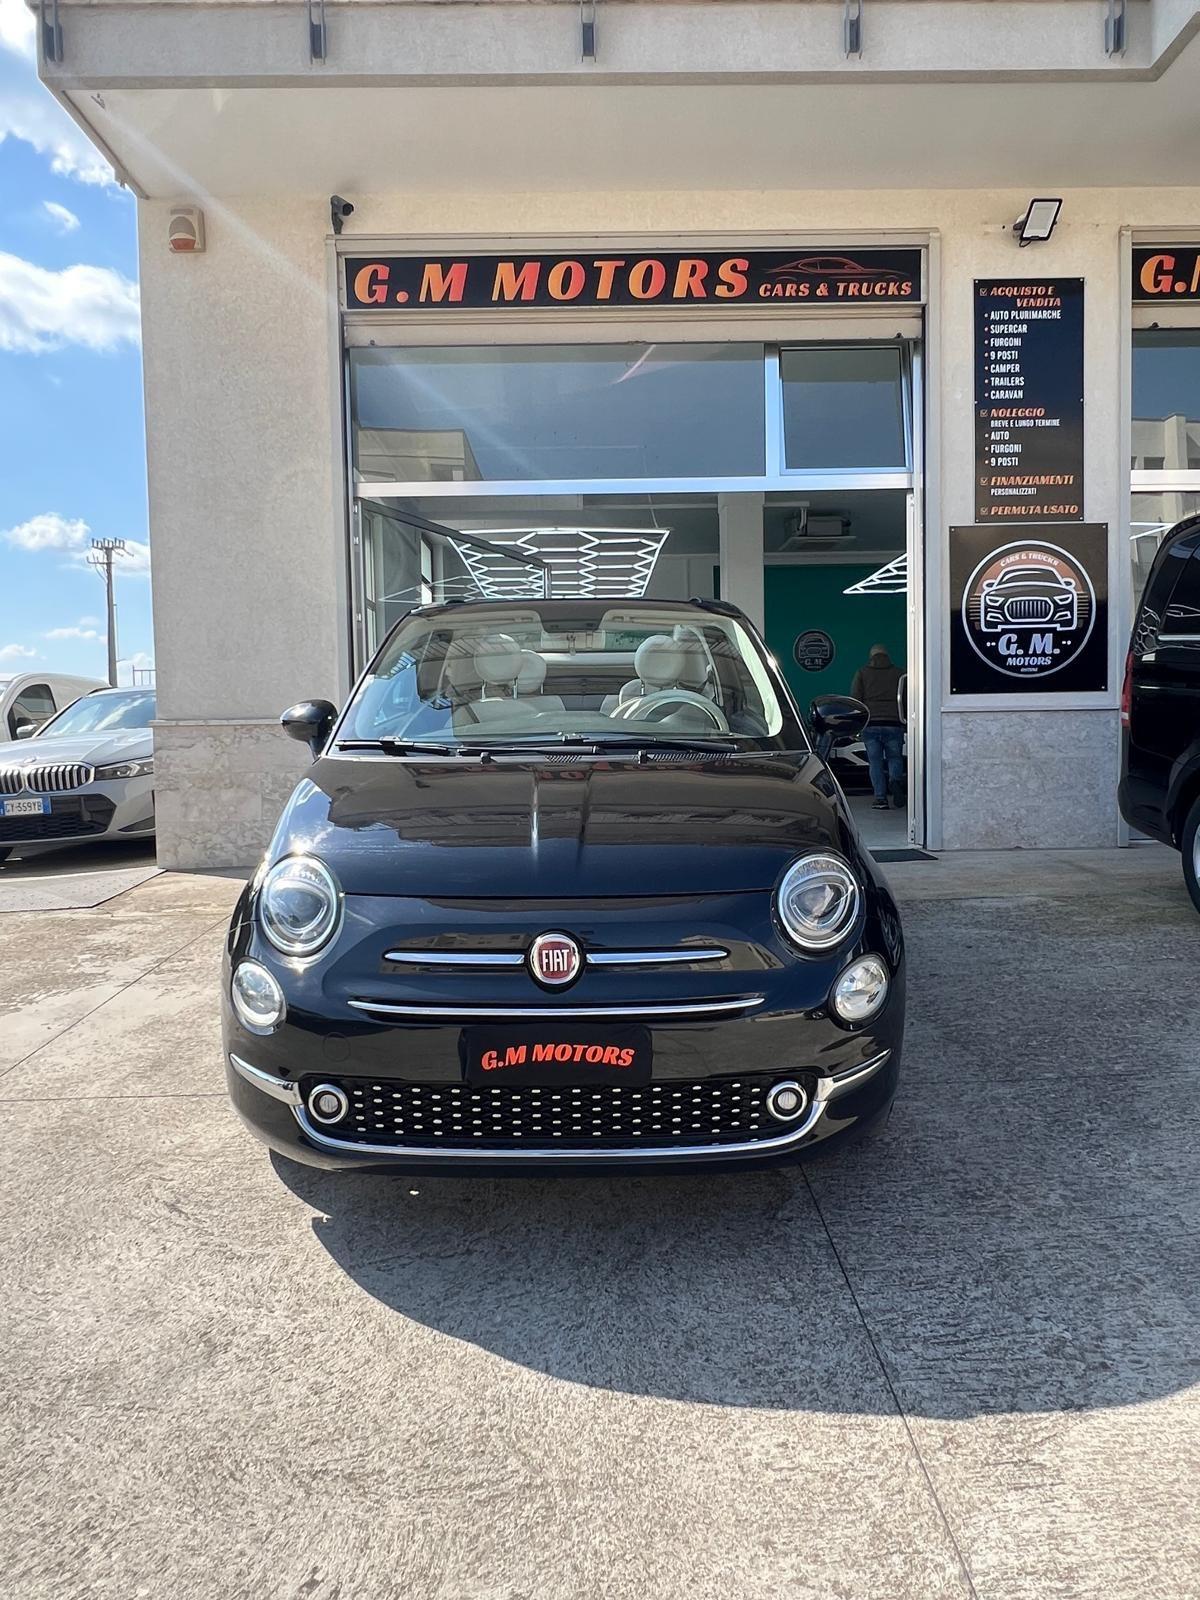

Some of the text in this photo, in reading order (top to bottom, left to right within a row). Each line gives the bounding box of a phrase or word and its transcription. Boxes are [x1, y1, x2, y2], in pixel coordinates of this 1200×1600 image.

[1140, 254, 1200, 294] G.
[354, 258, 750, 304] G.M MOTORS
[758, 281, 912, 297] CARS & TRUCKS
[990, 286, 1056, 297] ACQUISTO E
[1016, 297, 1061, 307] VENDITA
[990, 310, 1061, 320] AUTO PLURIMARCHE
[990, 324, 1028, 334] SUPERCAR
[990, 337, 1022, 347] FURGONI
[990, 350, 1018, 360] 9 POSTI
[990, 364, 1020, 373] CAMPER
[990, 377, 1025, 386] TRAILERS
[990, 390, 1023, 399] CARAVAN
[990, 408, 1045, 417] NOLEGGIO
[1015, 419, 1034, 427] LUNGO
[990, 431, 1010, 440] AUTO
[990, 444, 1022, 453] FURGONI
[990, 457, 1018, 467] 9 POSTI
[990, 475, 1074, 485] FINANZIAMENTI
[990, 487, 1037, 496] PERSONALIZZATI
[990, 505, 1079, 515] PERMUTA USATO
[1000, 553, 1020, 567] CARS
[1028, 552, 1060, 566] TRUCKS
[998, 633, 1060, 655] G. M.
[1006, 656, 1052, 666] MOTORS
[541, 949, 570, 972] FIAT
[481, 1044, 635, 1071] G.M MOTORS
